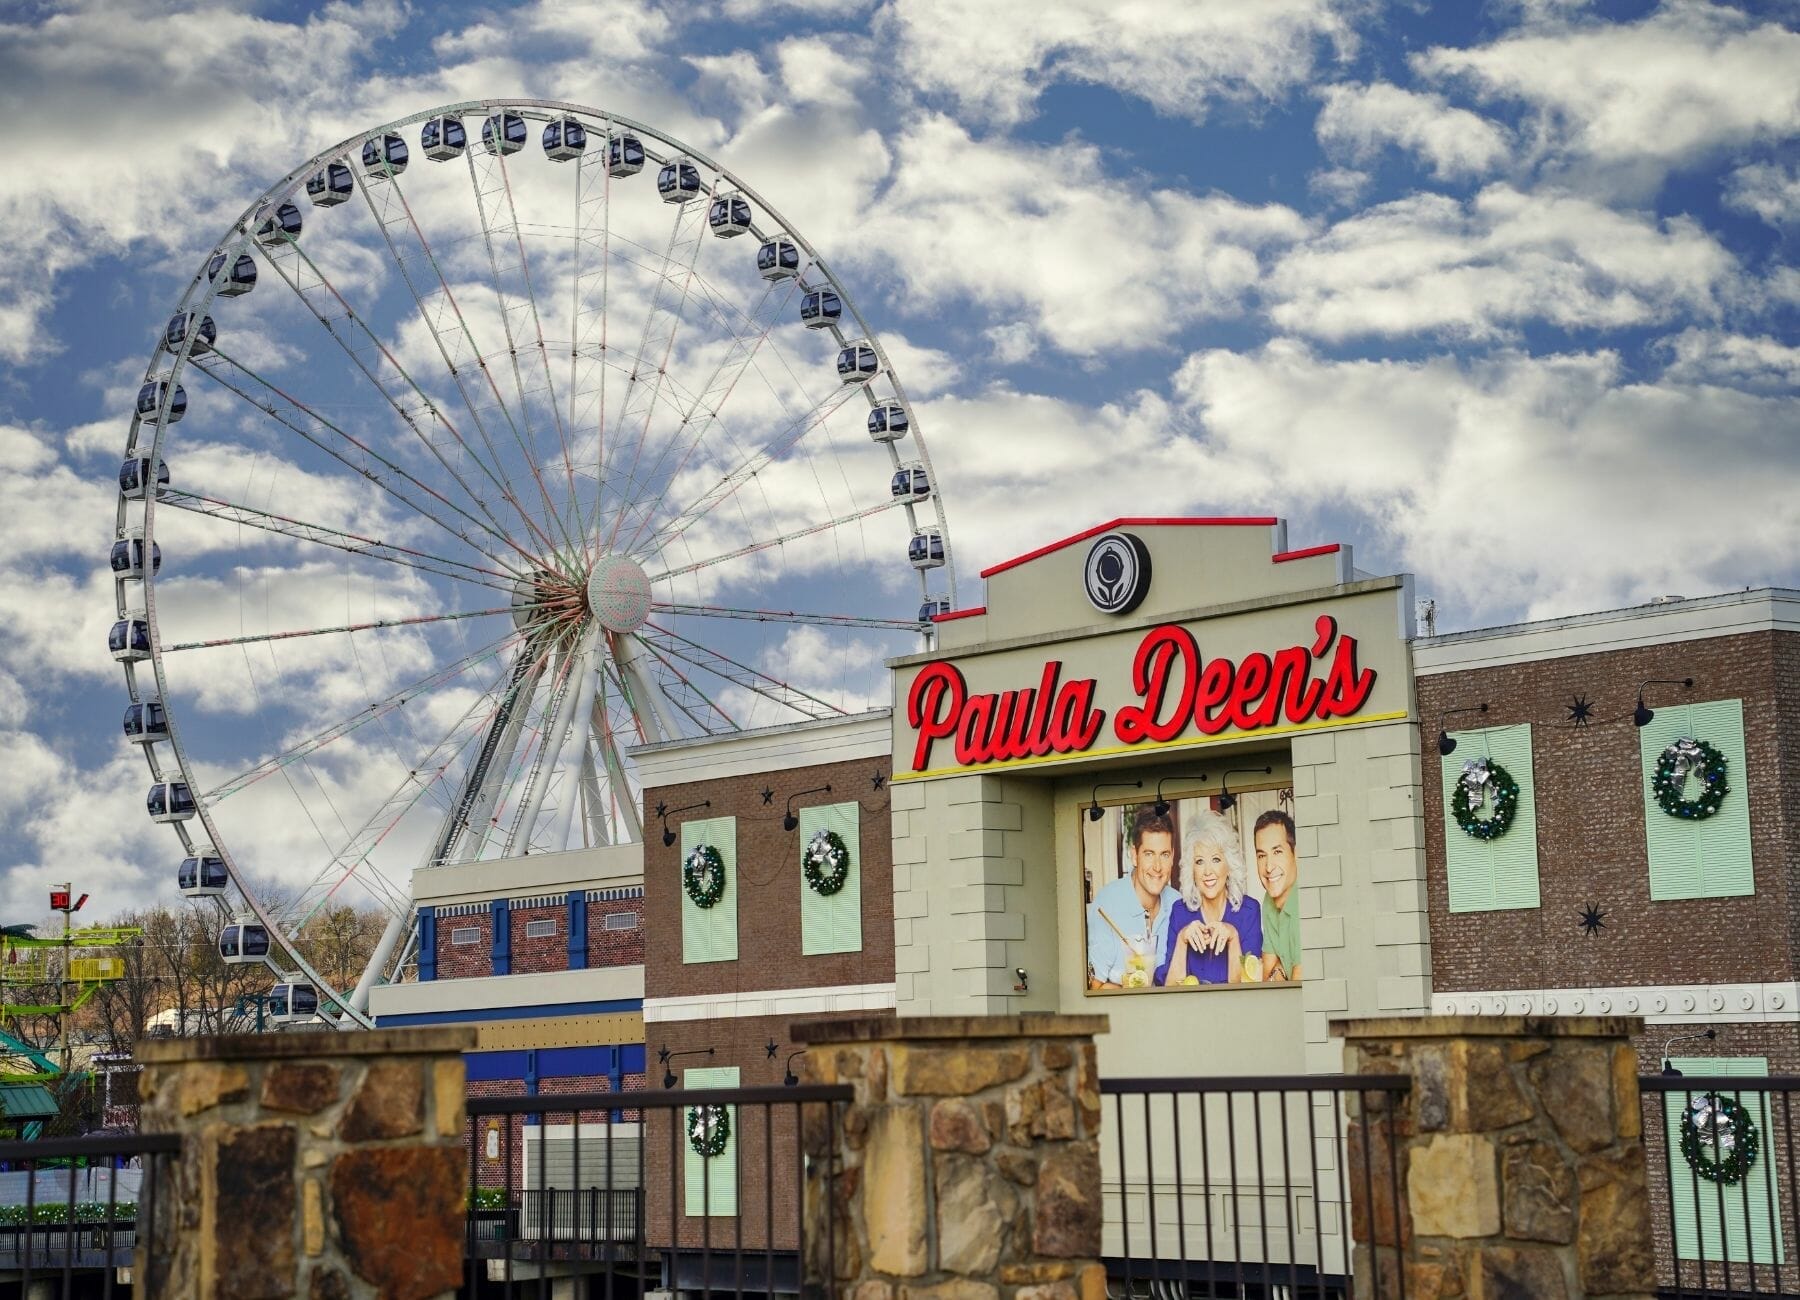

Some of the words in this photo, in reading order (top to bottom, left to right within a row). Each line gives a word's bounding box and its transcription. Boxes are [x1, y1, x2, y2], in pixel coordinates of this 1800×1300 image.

[908, 662, 1106, 771] Paula
[1114, 615, 1377, 743] Deen's
[52, 894, 68, 906] 30
